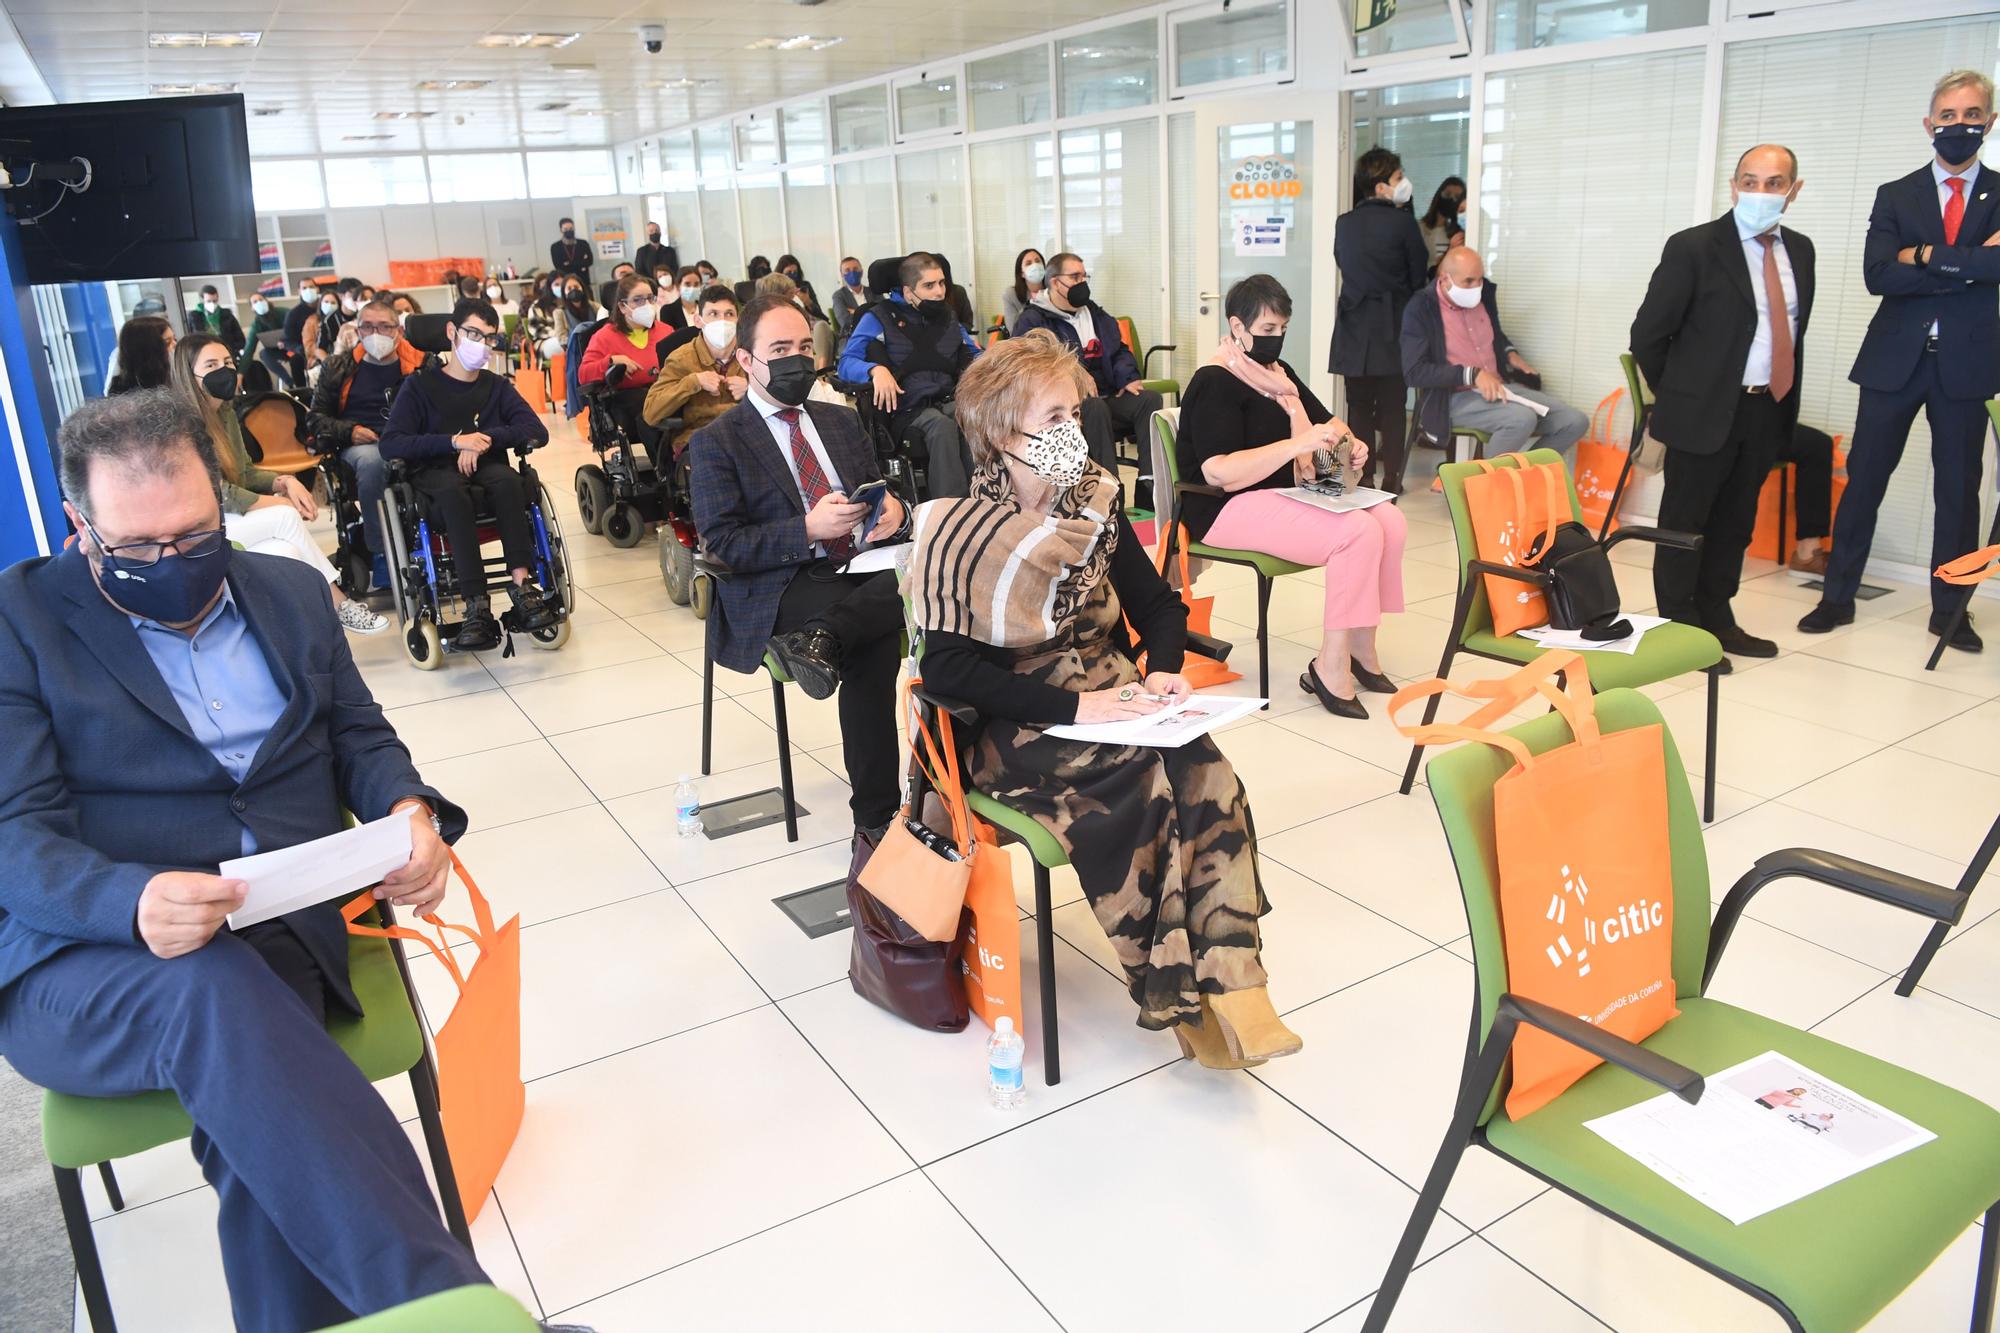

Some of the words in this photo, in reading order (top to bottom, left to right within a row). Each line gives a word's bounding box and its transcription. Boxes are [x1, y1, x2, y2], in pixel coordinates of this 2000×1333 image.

[1230, 181, 1302, 199] CLOUD
[1603, 899, 1662, 943] citic
[978, 944, 1005, 970] tic
[1628, 992, 1639, 1003] DA
